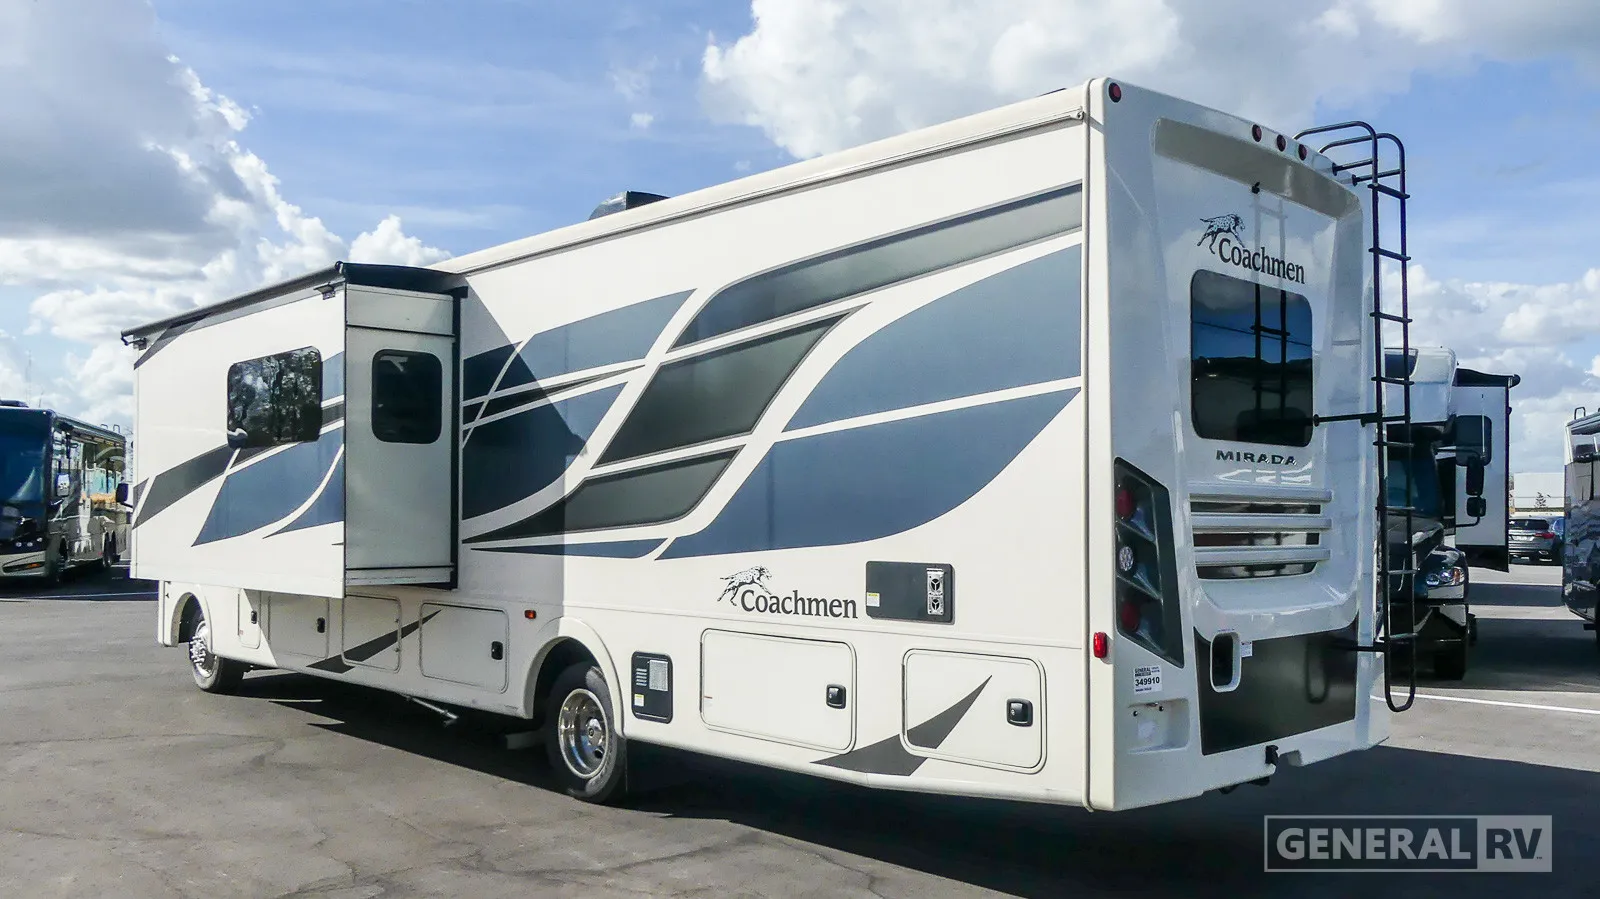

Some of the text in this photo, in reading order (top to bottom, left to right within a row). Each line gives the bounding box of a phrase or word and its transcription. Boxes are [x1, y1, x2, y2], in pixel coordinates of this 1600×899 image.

[1218, 238, 1305, 284] Coachmen
[1215, 449, 1297, 466] MIRADA
[740, 589, 858, 619] Coachmen
[1135, 676, 1160, 686] 349910
